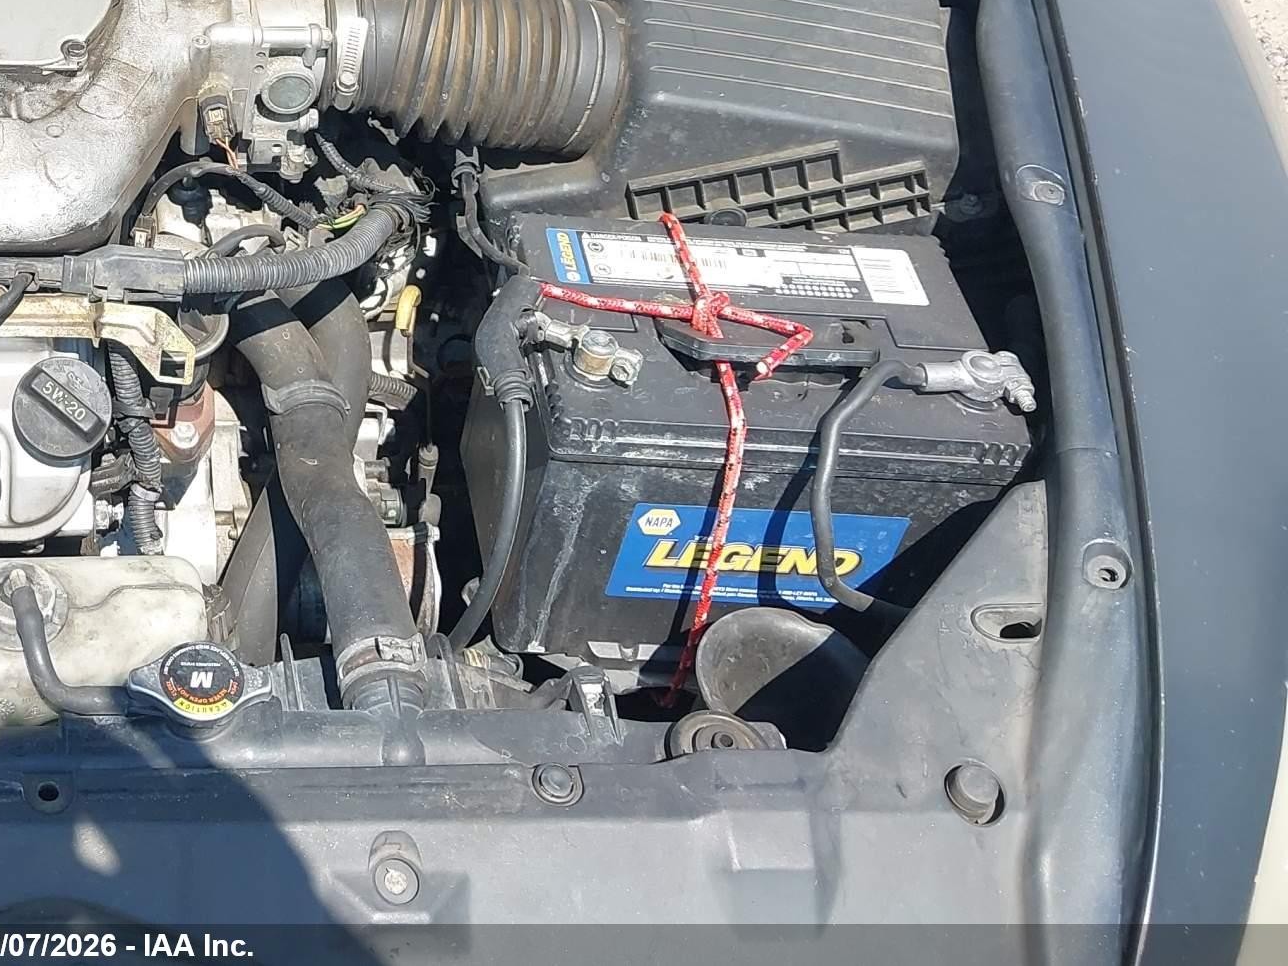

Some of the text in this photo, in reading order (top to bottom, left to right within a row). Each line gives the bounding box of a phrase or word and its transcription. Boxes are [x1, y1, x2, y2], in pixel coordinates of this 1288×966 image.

[557, 232, 579, 272] LEGEND
[644, 516, 674, 529] NAPA
[644, 537, 862, 576] LEGEND
[190, 671, 214, 689] M
[178, 700, 221, 713] CAUTION
[188, 695, 208, 704] OPEN
